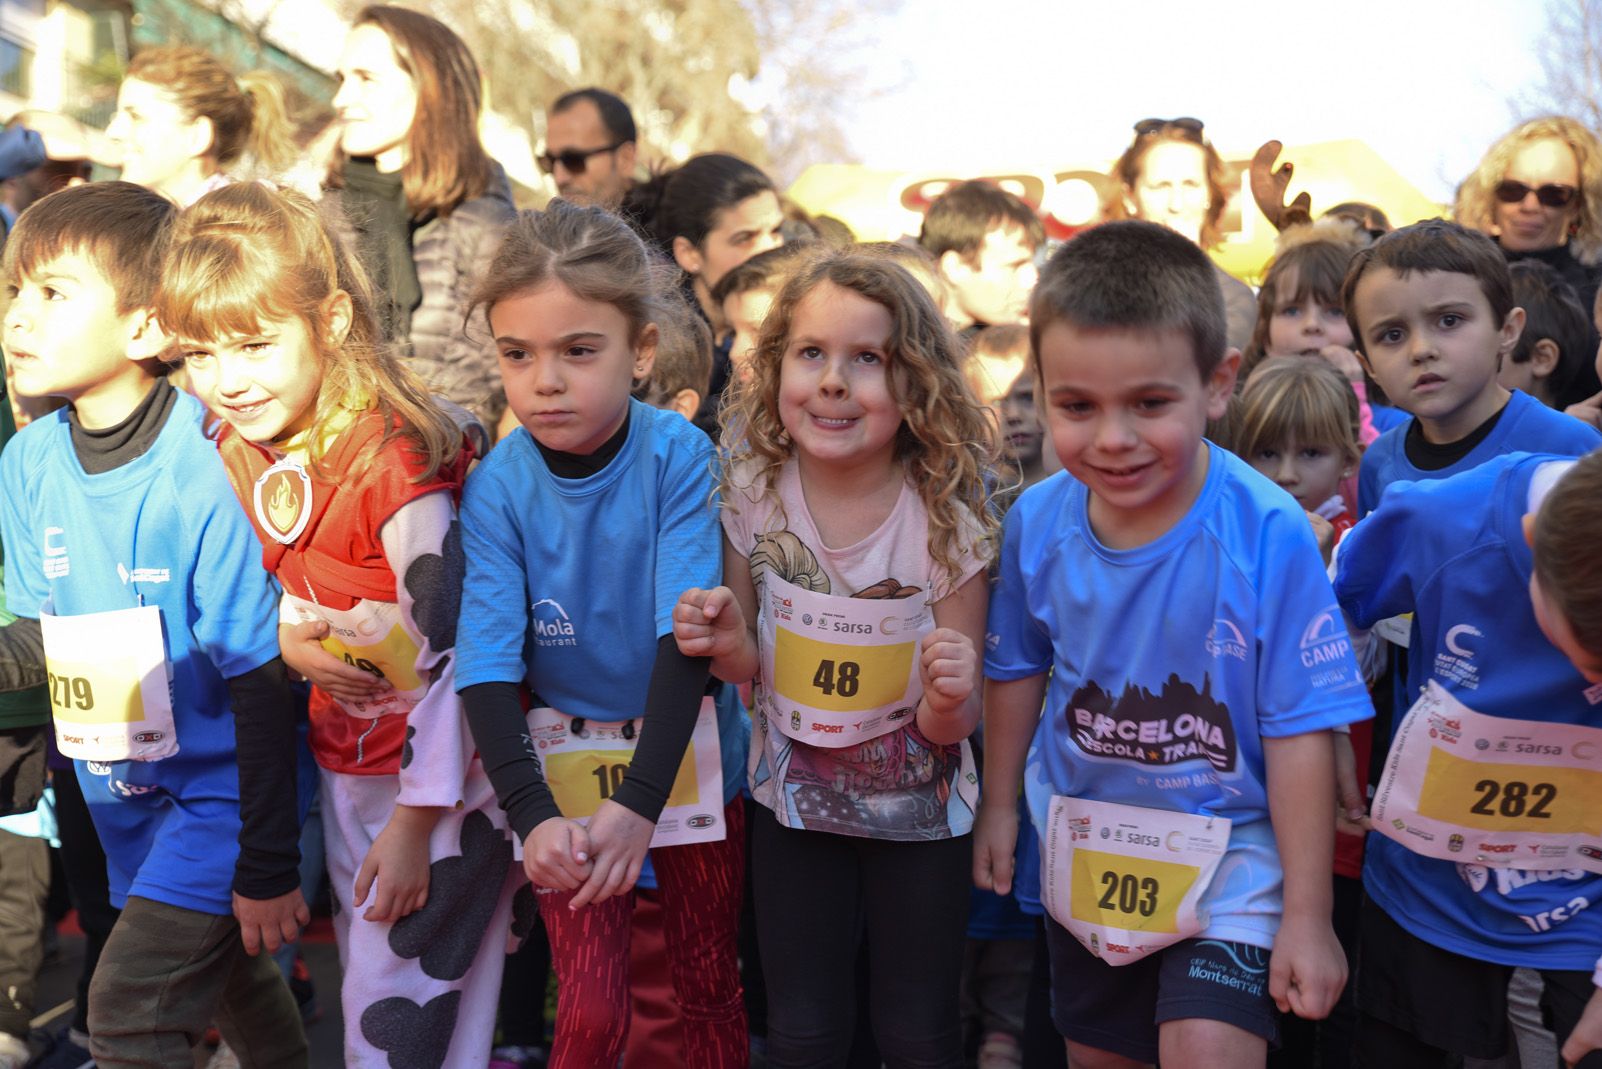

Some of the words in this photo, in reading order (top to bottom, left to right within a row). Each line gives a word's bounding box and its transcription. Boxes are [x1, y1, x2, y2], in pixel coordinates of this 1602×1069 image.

[833, 621, 872, 634] sarsa
[1301, 639, 1349, 668] CAMP
[812, 659, 860, 698] 48
[49, 671, 94, 711] 279
[811, 722, 844, 734] SPORT
[1515, 742, 1563, 756] sarsa
[1154, 775, 1190, 789] CAMP
[1192, 773, 1218, 787] BAS
[1470, 779, 1557, 819] 282
[1127, 832, 1160, 847] sarsa
[1479, 843, 1518, 853] SPORT
[1098, 870, 1160, 917] 203
[1188, 965, 1263, 997] Montserrat
